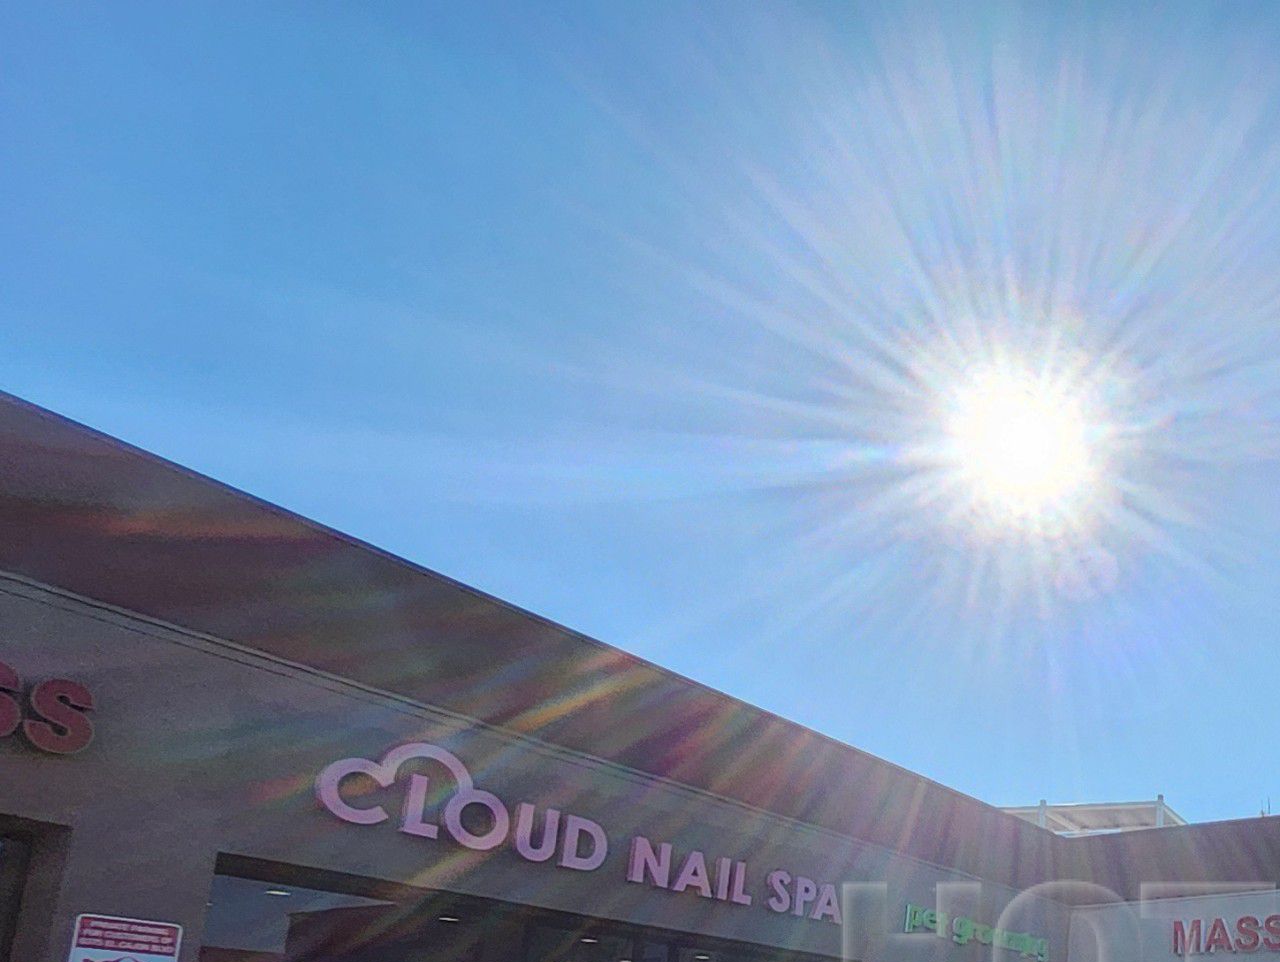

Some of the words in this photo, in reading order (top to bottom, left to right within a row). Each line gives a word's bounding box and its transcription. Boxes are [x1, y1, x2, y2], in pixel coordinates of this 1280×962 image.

[315, 742, 608, 871] CLOUD
[627, 836, 752, 906] NAIL
[766, 868, 844, 925] SPA
